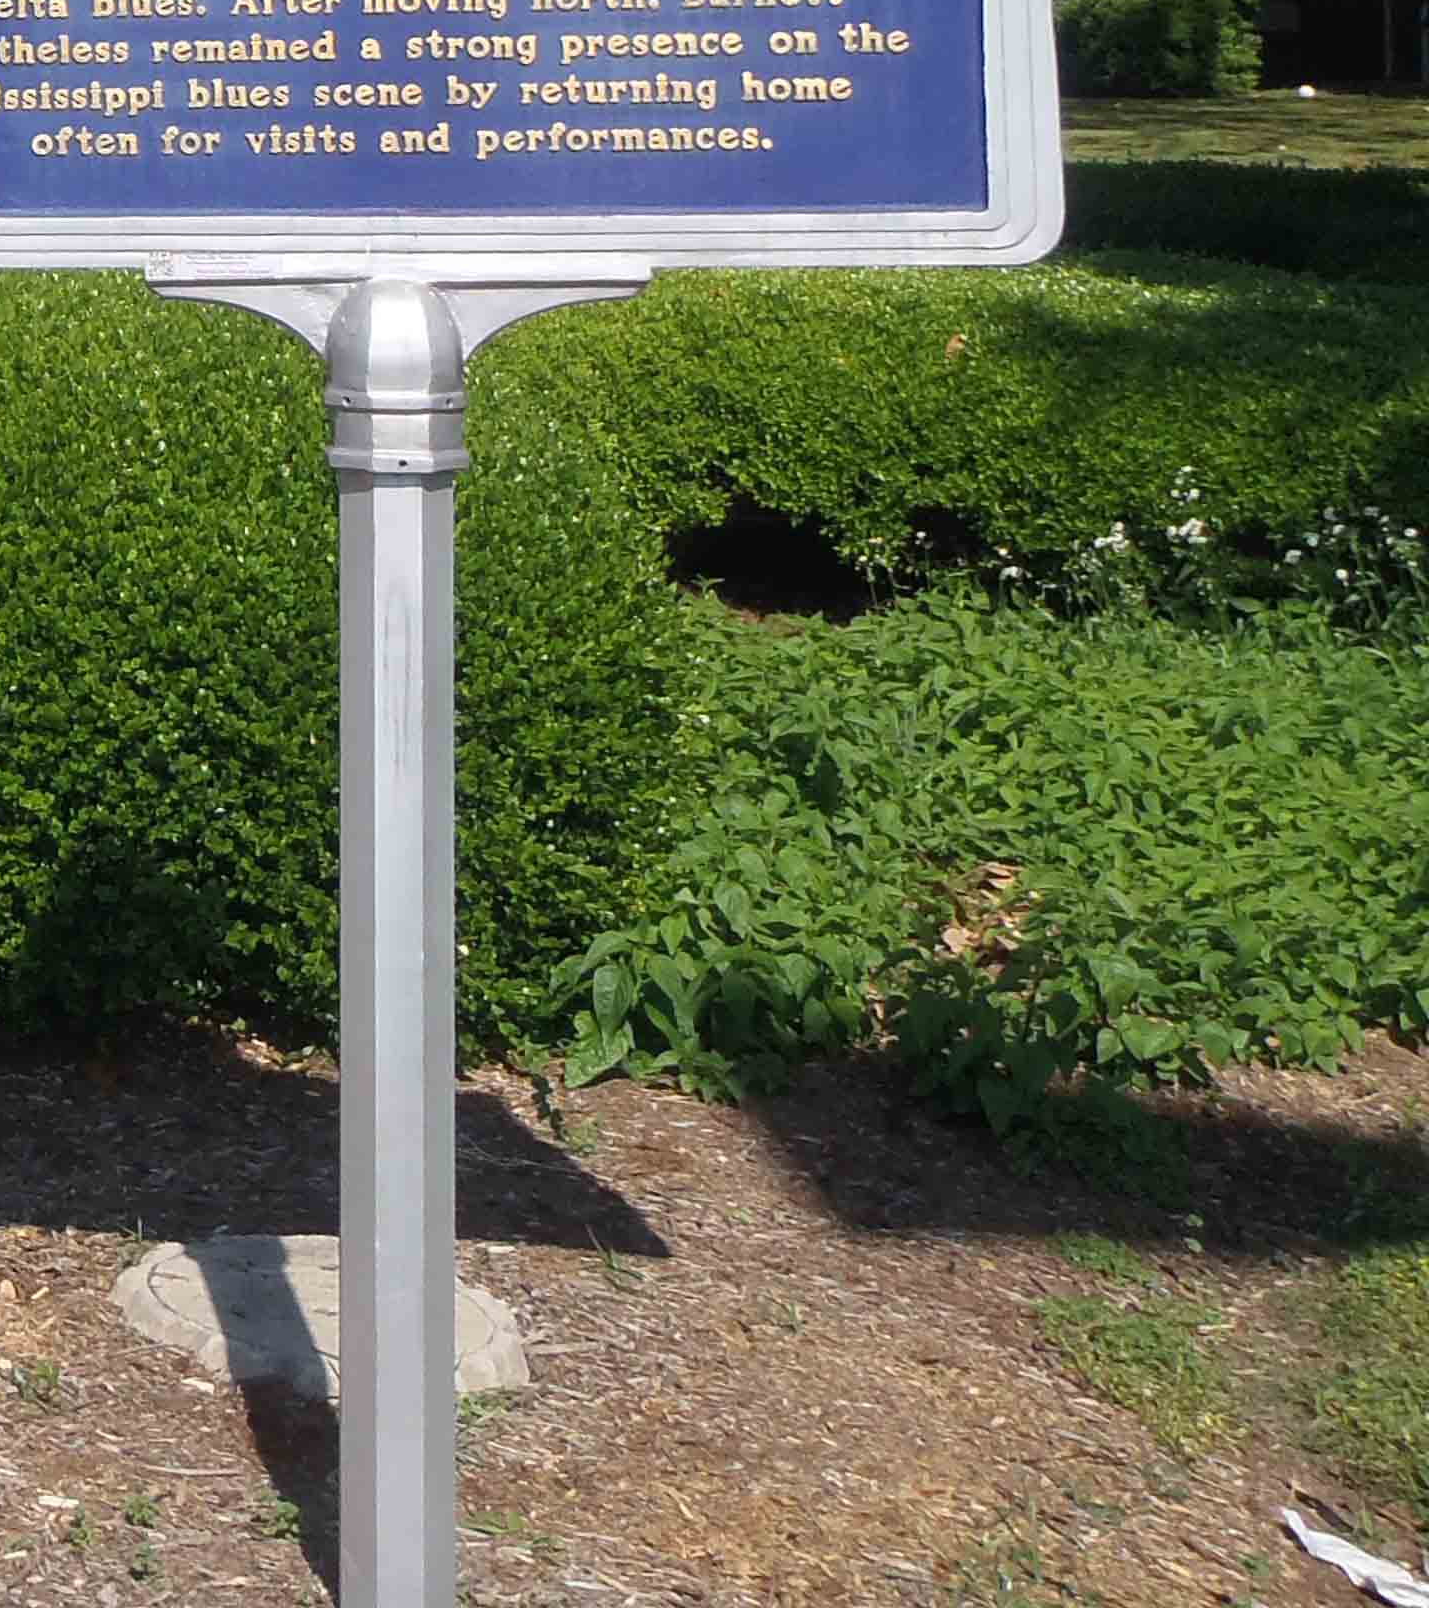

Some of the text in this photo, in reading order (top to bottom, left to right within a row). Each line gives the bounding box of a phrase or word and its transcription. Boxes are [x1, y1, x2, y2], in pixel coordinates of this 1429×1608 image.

[154, 30, 340, 65] remained
[363, 39, 385, 62] a
[406, 31, 541, 67] strong
[564, 31, 744, 67] presence
[769, 30, 822, 57] on
[840, 23, 912, 56] the
[189, 79, 291, 111] blues
[317, 83, 425, 107] scene
[448, 76, 502, 111] by
[521, 72, 720, 113] returning
[743, 72, 855, 105] home
[33, 121, 775, 162] often for visits and performances.
